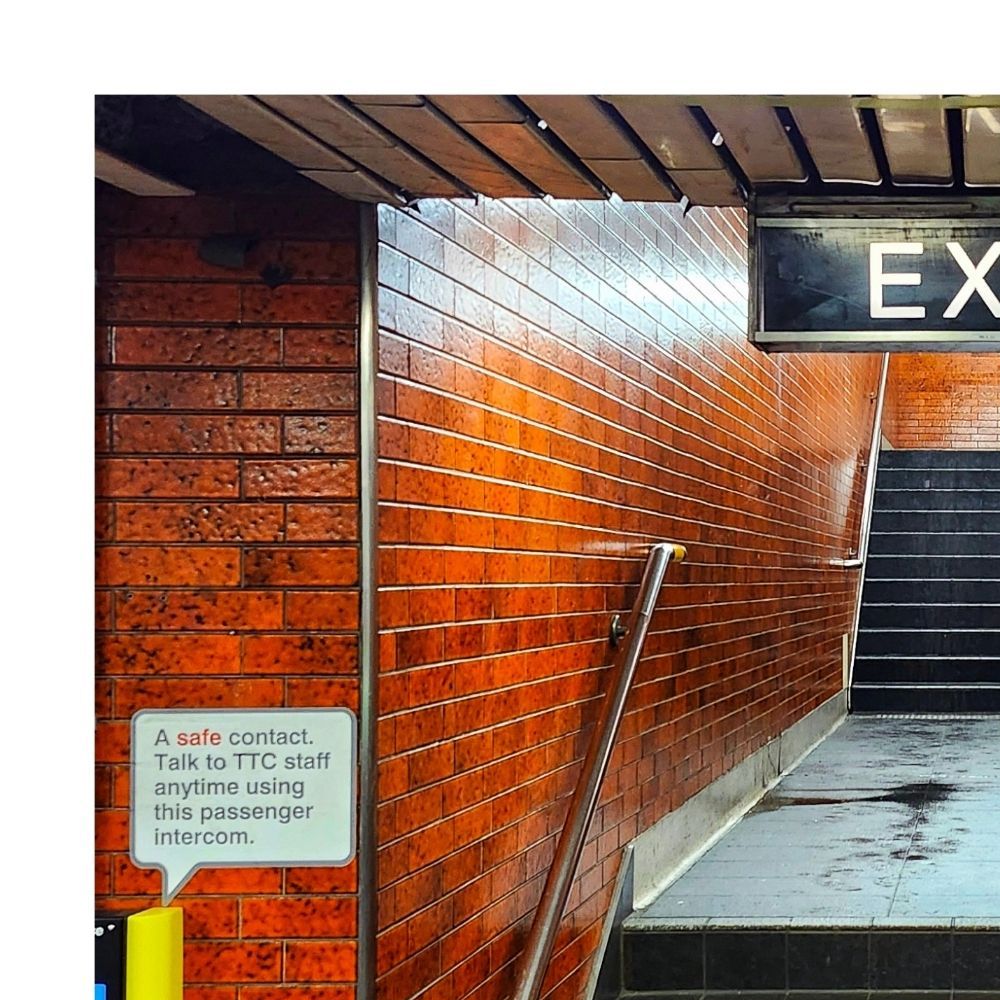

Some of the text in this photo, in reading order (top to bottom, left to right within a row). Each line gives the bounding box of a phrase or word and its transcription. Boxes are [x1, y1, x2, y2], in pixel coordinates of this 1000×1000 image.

[154, 728, 314, 746] A safe contact.
[154, 751, 331, 770] Talk to TTC staff
[154, 777, 304, 799] anytime using
[154, 803, 314, 824] this passenger
[154, 828, 254, 845] intercom.
